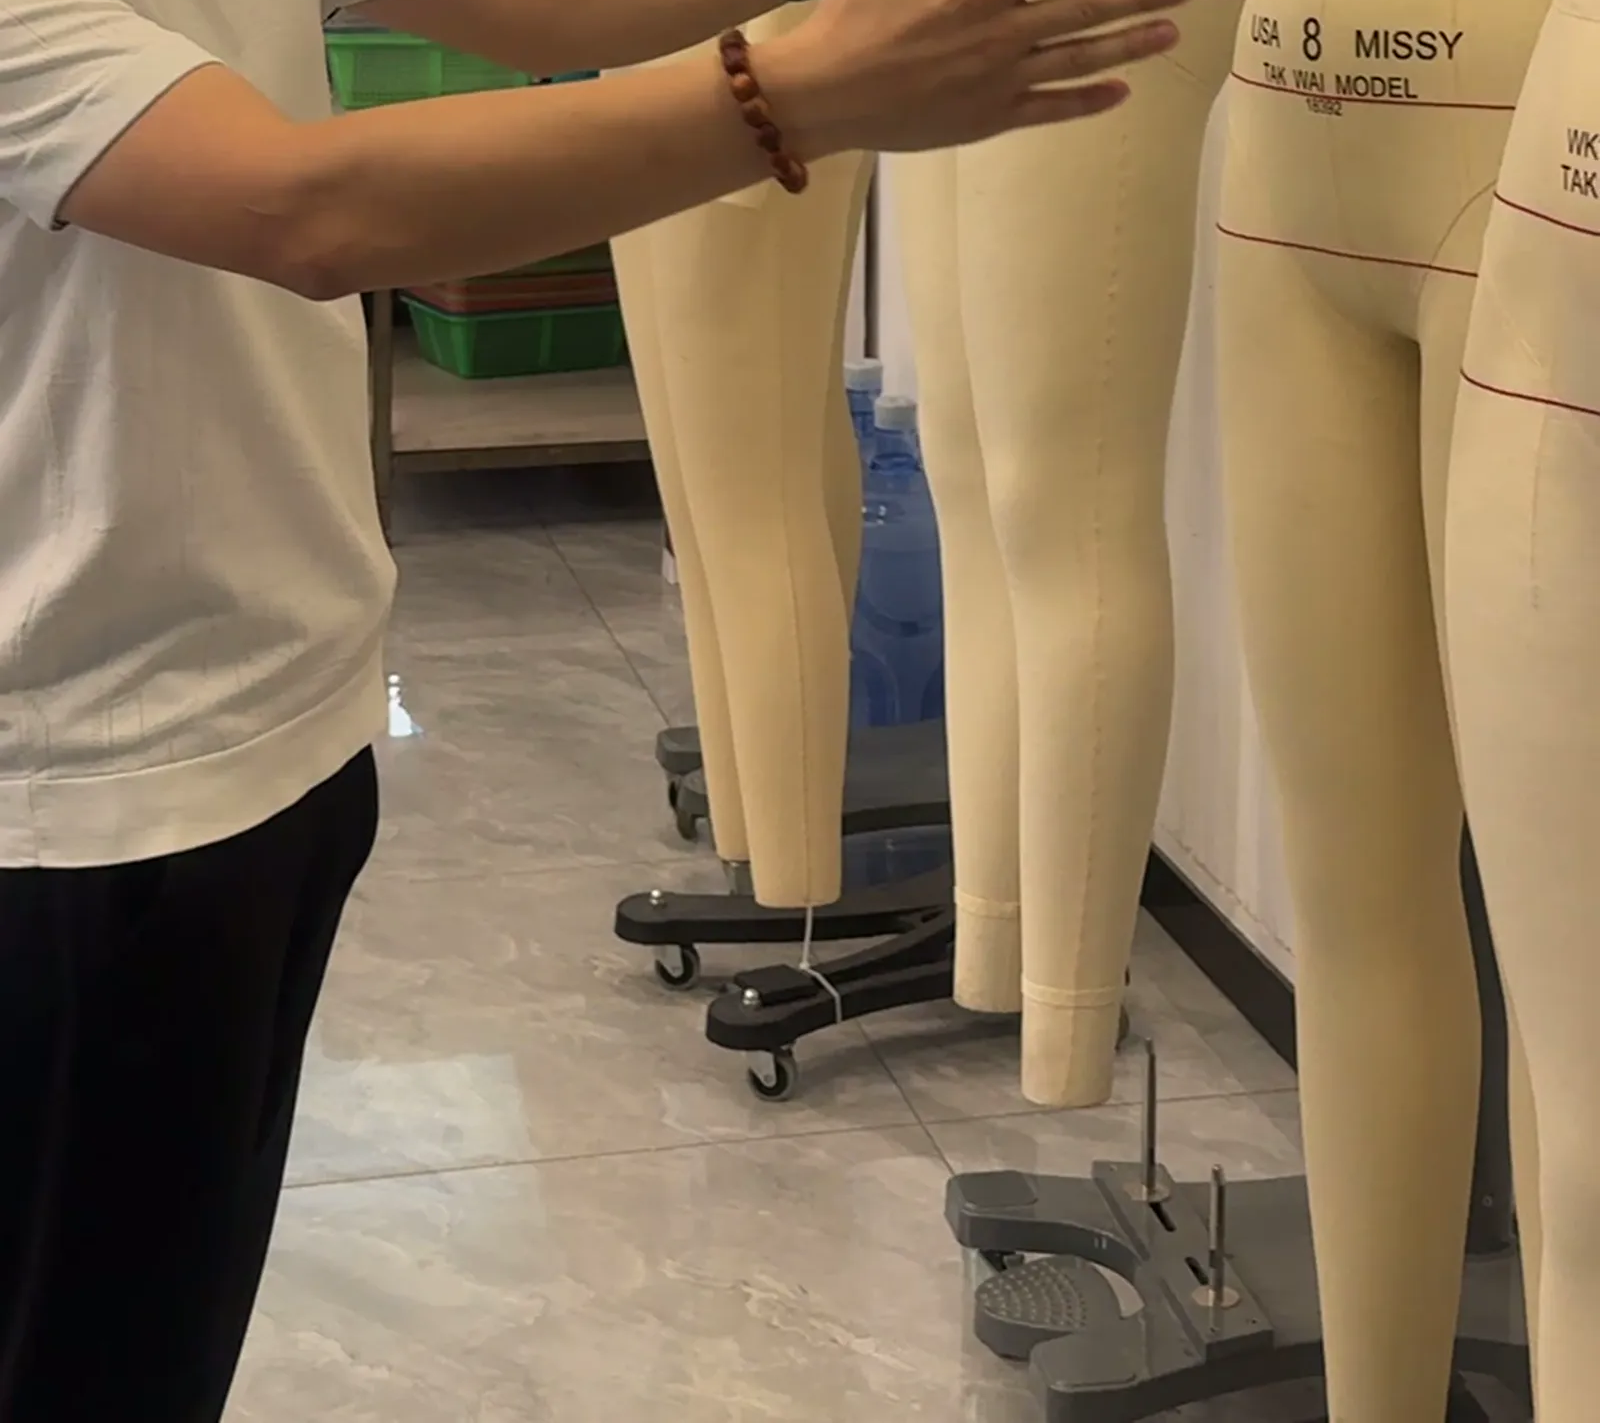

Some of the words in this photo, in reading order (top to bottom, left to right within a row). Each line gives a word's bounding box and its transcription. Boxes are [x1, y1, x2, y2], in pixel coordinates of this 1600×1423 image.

[1251, 14, 1281, 48] USA
[1302, 17, 1322, 62] 8
[1355, 29, 1464, 60] MISSY
[1263, 62, 1287, 86] TAK
[1292, 69, 1325, 93] WAI
[1335, 74, 1419, 99] MODEL
[1567, 127, 1600, 161] WK
[1560, 163, 1599, 199] TAK
